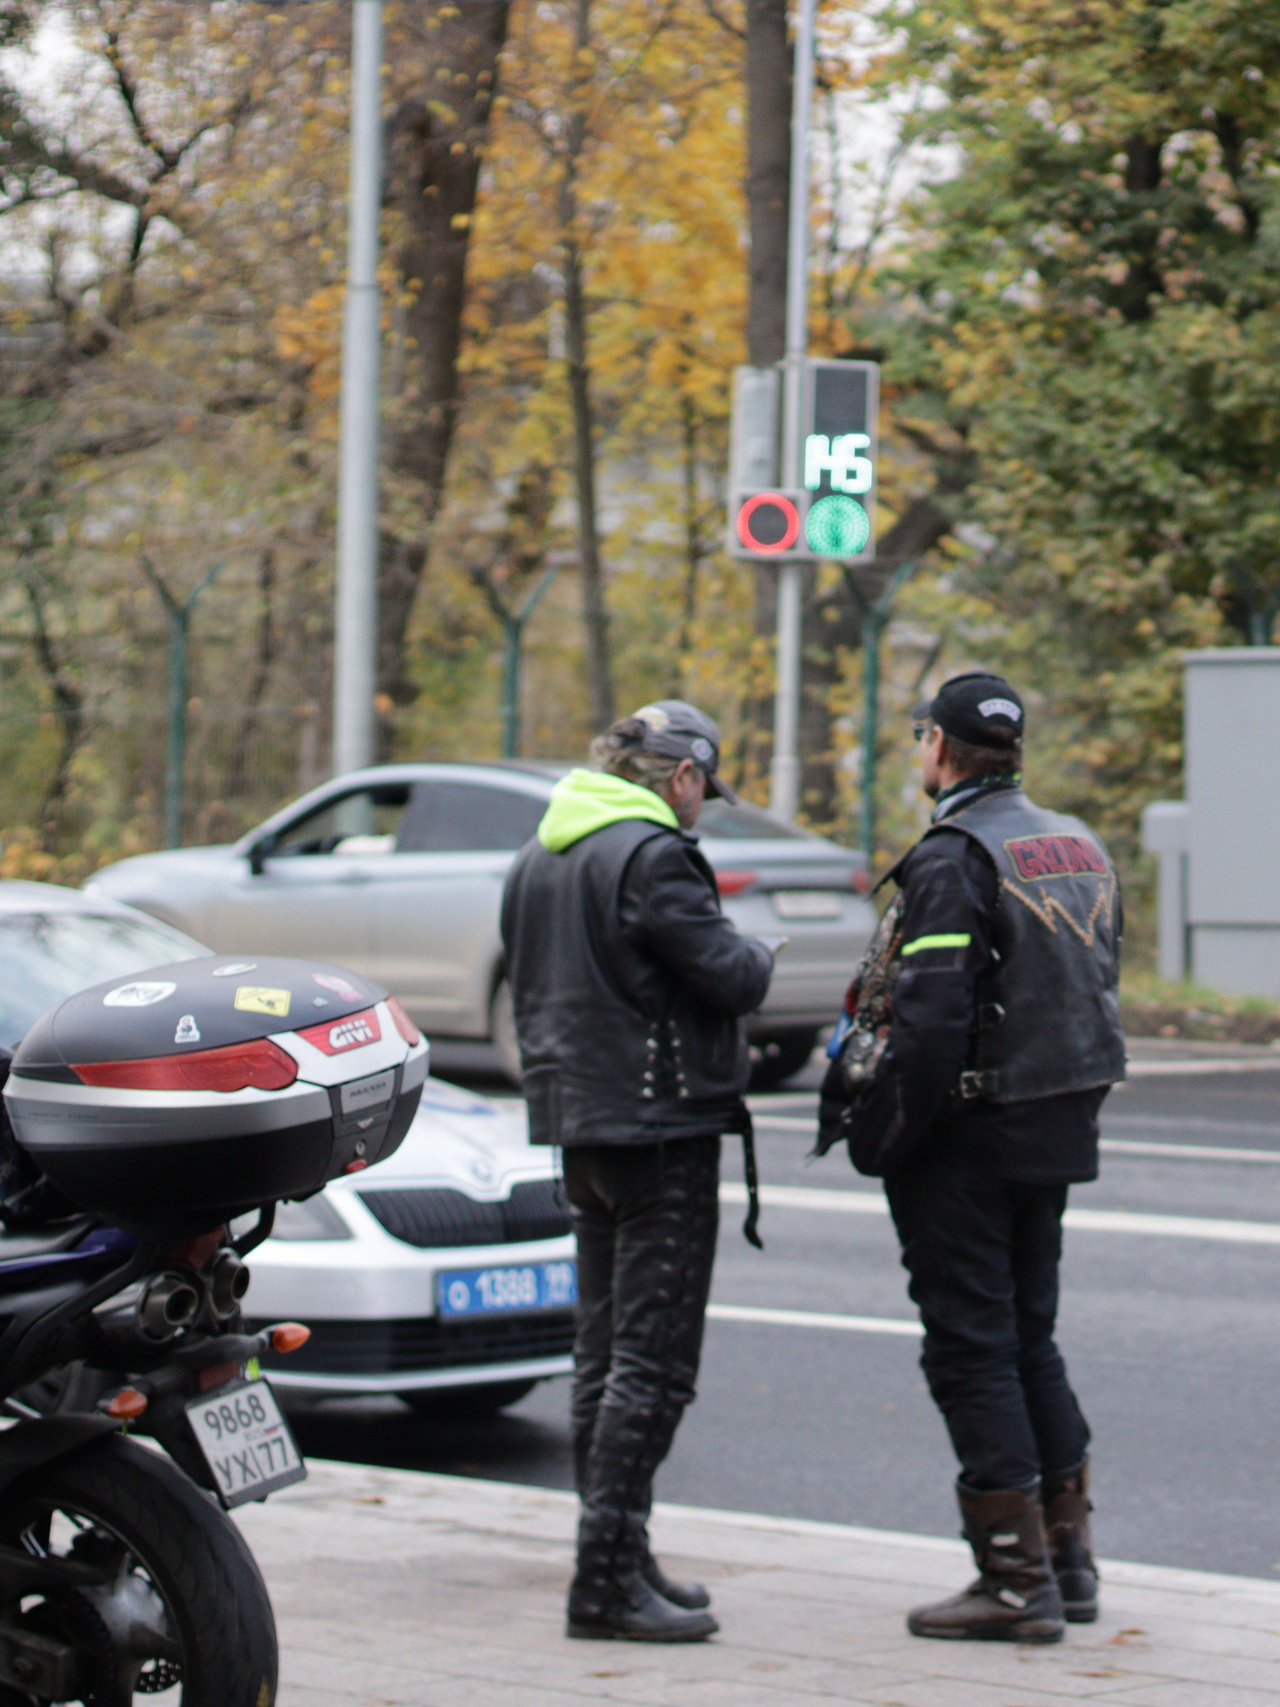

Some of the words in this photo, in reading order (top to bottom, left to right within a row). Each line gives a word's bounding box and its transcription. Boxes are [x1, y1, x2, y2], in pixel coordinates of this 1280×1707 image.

[328, 1019, 374, 1049] GIVI
[204, 1393, 266, 1440] 9868
[257, 1436, 289, 1472] 77
